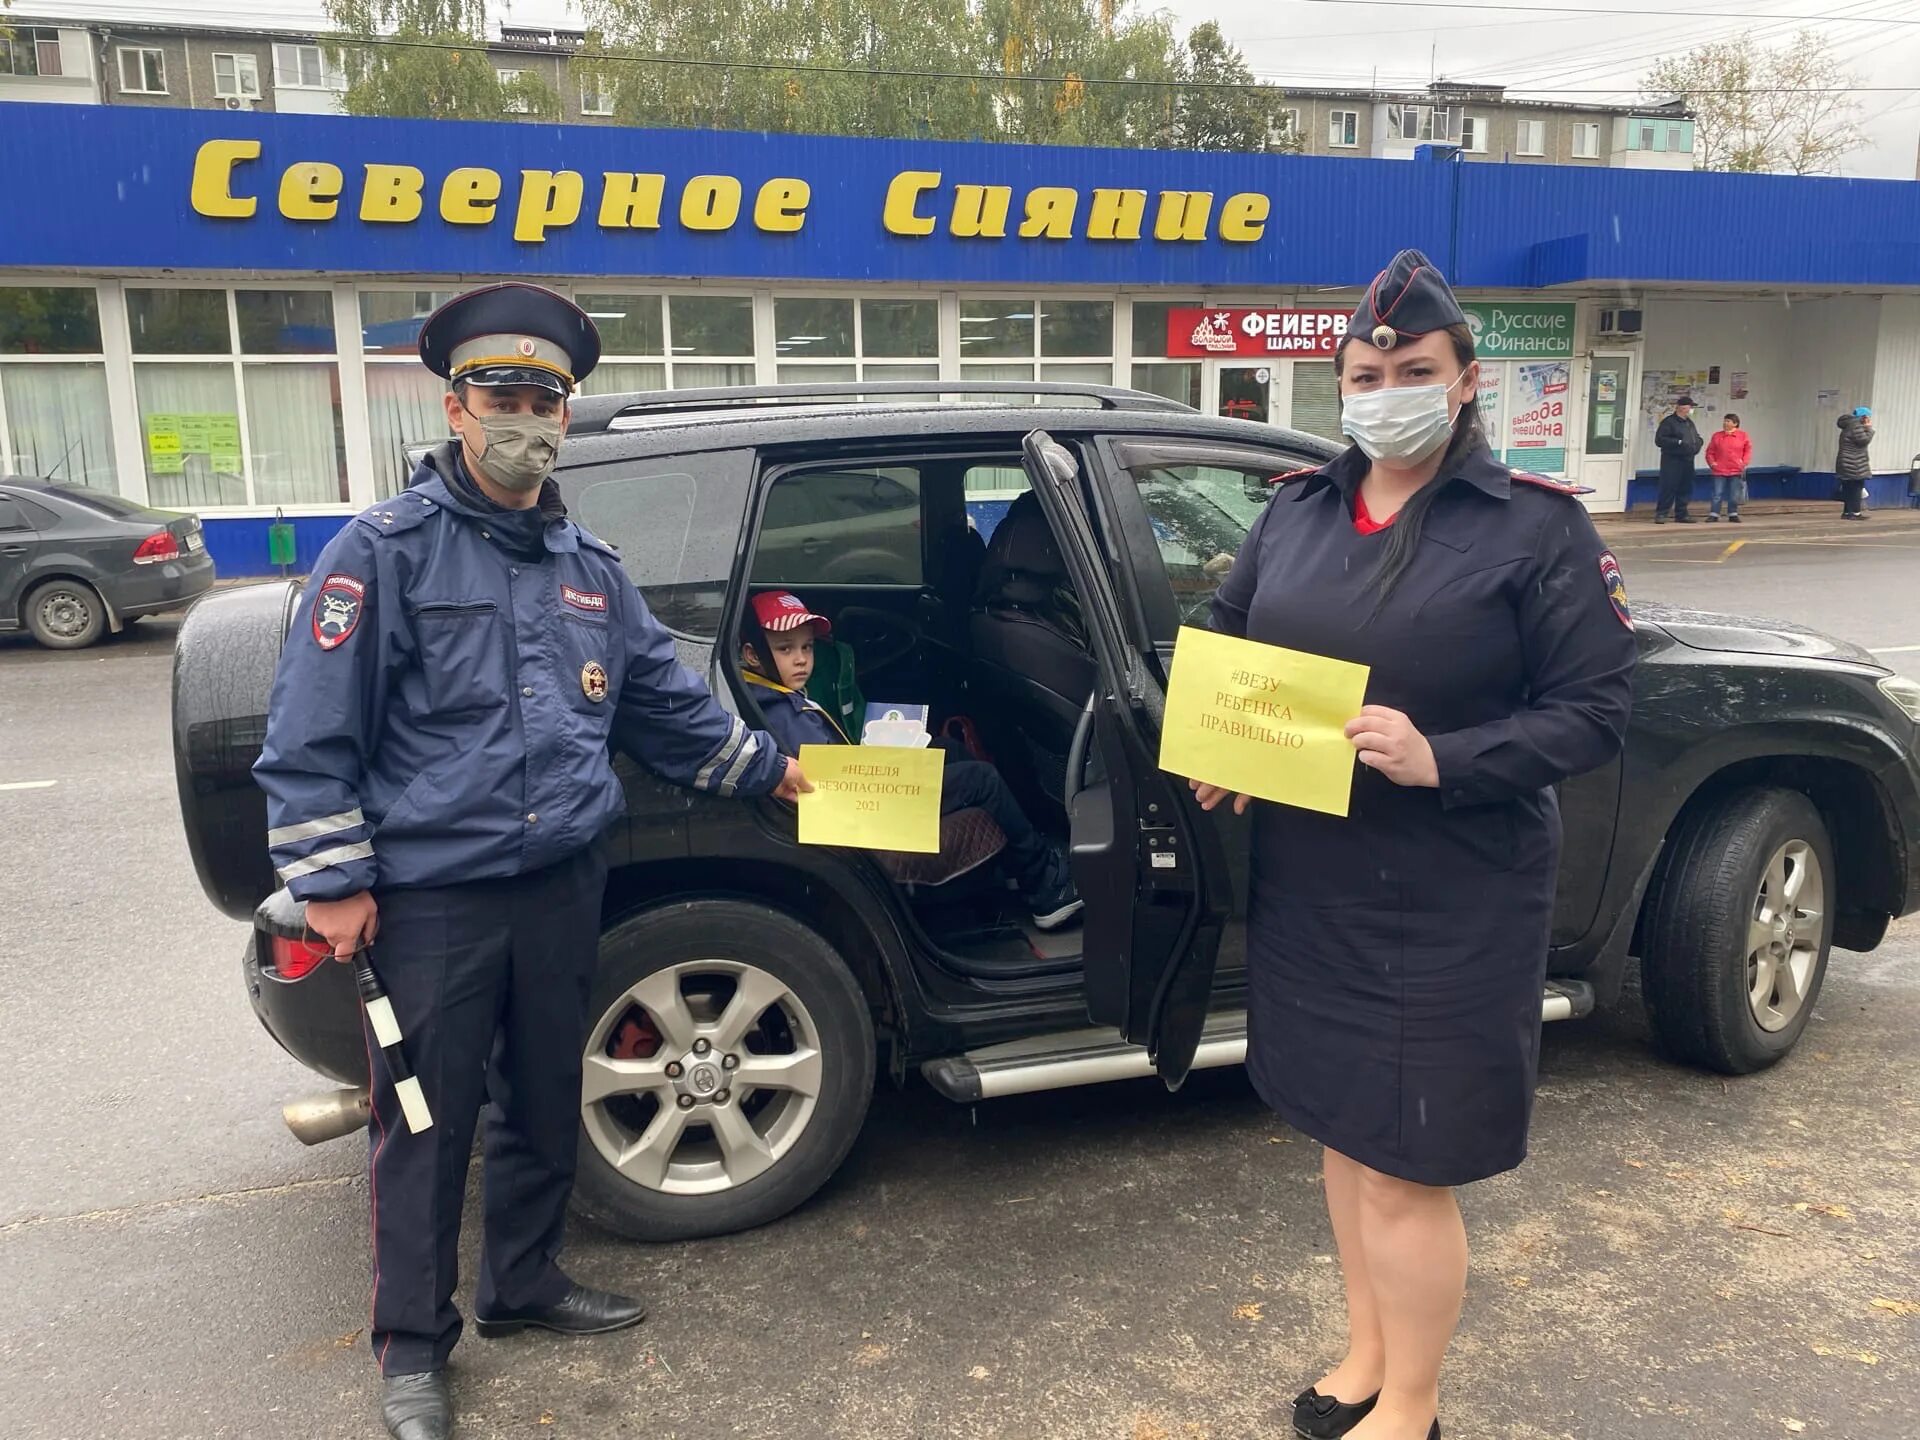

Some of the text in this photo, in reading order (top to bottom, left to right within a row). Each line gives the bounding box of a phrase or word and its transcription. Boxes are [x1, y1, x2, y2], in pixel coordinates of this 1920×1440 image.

[190, 138, 1271, 244] Северное Сияние
[1241, 312, 1352, 337] ФЕЙЕРВ
[1491, 309, 1566, 333] Русские
[1267, 337, 1316, 350] ШАРЫ
[1321, 337, 1331, 349] С
[1485, 331, 1570, 350] Финансы
[1231, 669, 1281, 692] #ВЕЗУ
[1215, 691, 1292, 720] РЕБЕНКА
[1200, 713, 1304, 749] ПРАВИЛЬНО
[841, 764, 899, 777] #НЕДЕЛЯ
[818, 780, 920, 796] БЕЗОПАСНОСТИ
[856, 800, 881, 811] 2021
